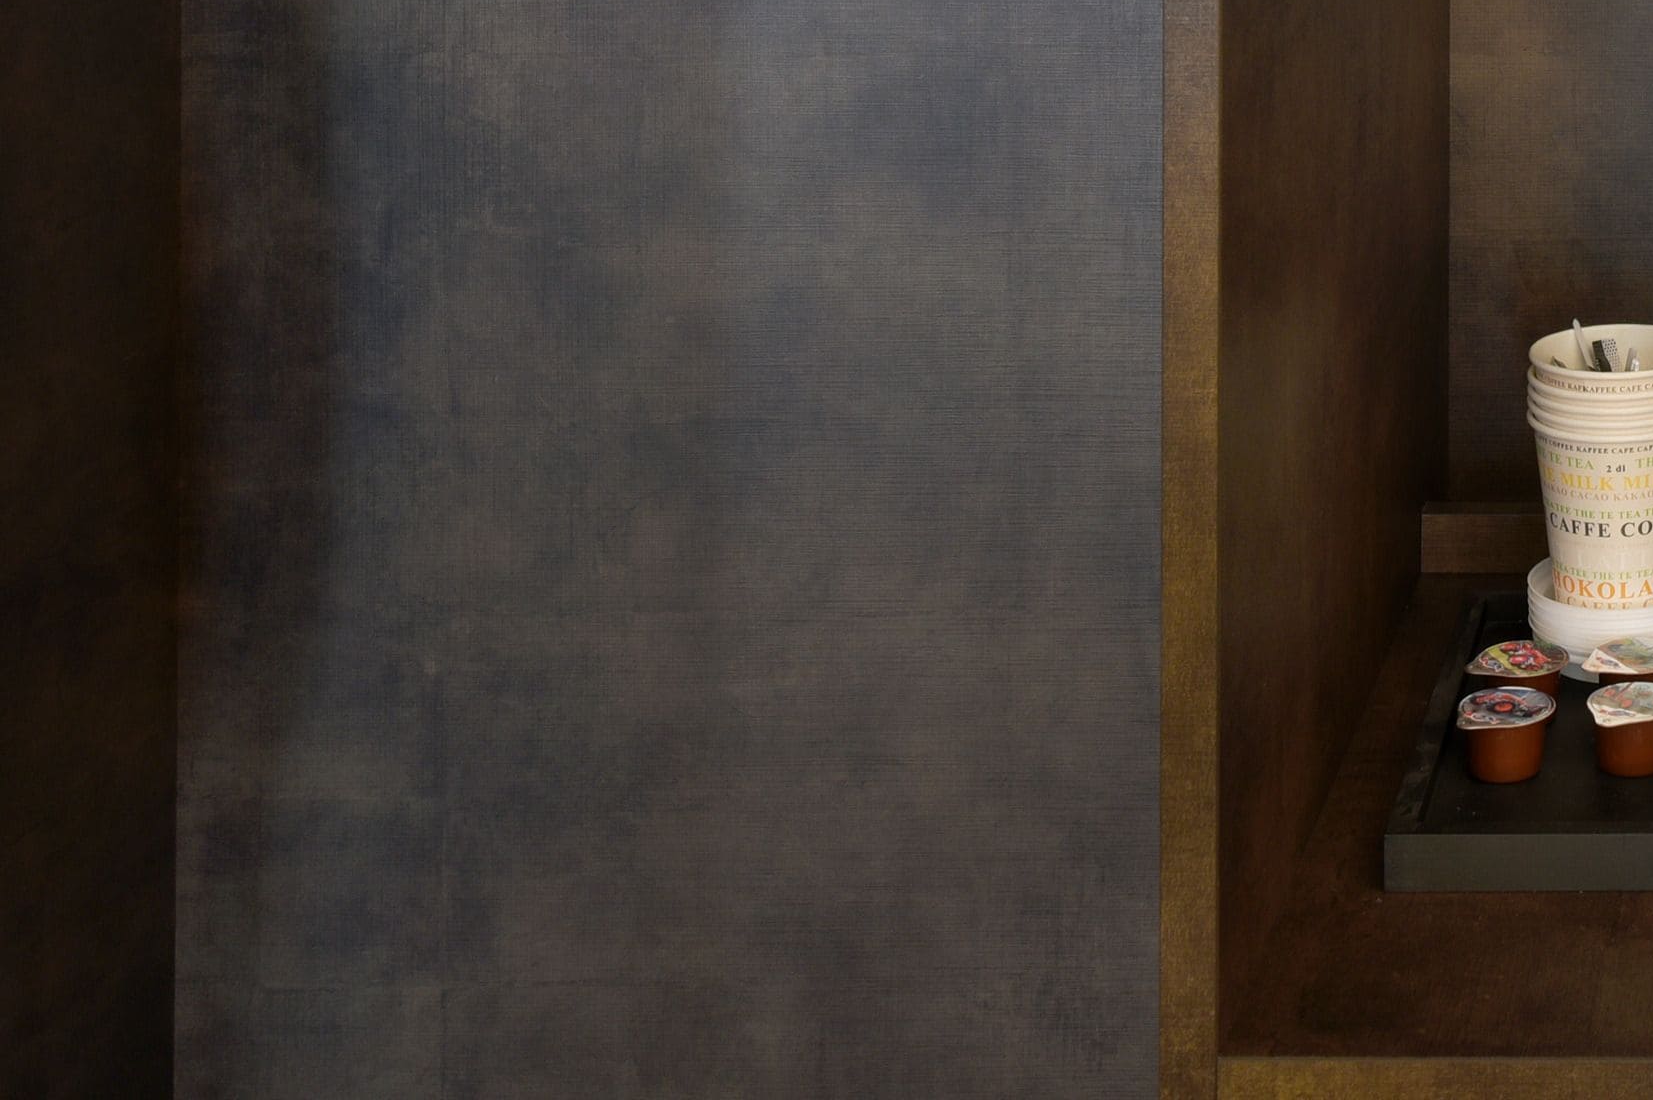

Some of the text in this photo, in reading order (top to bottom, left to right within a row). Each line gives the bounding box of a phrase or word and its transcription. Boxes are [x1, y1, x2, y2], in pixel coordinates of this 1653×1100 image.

[1576, 445, 1609, 454] KAFFEE
[1567, 456, 1595, 471] TEA
[1606, 464, 1612, 473] 2
[1561, 471, 1615, 492] MILK
[1570, 488, 1609, 501] CACAO
[1618, 509, 1641, 519] TEA
[1549, 511, 1611, 538] CAFFE
